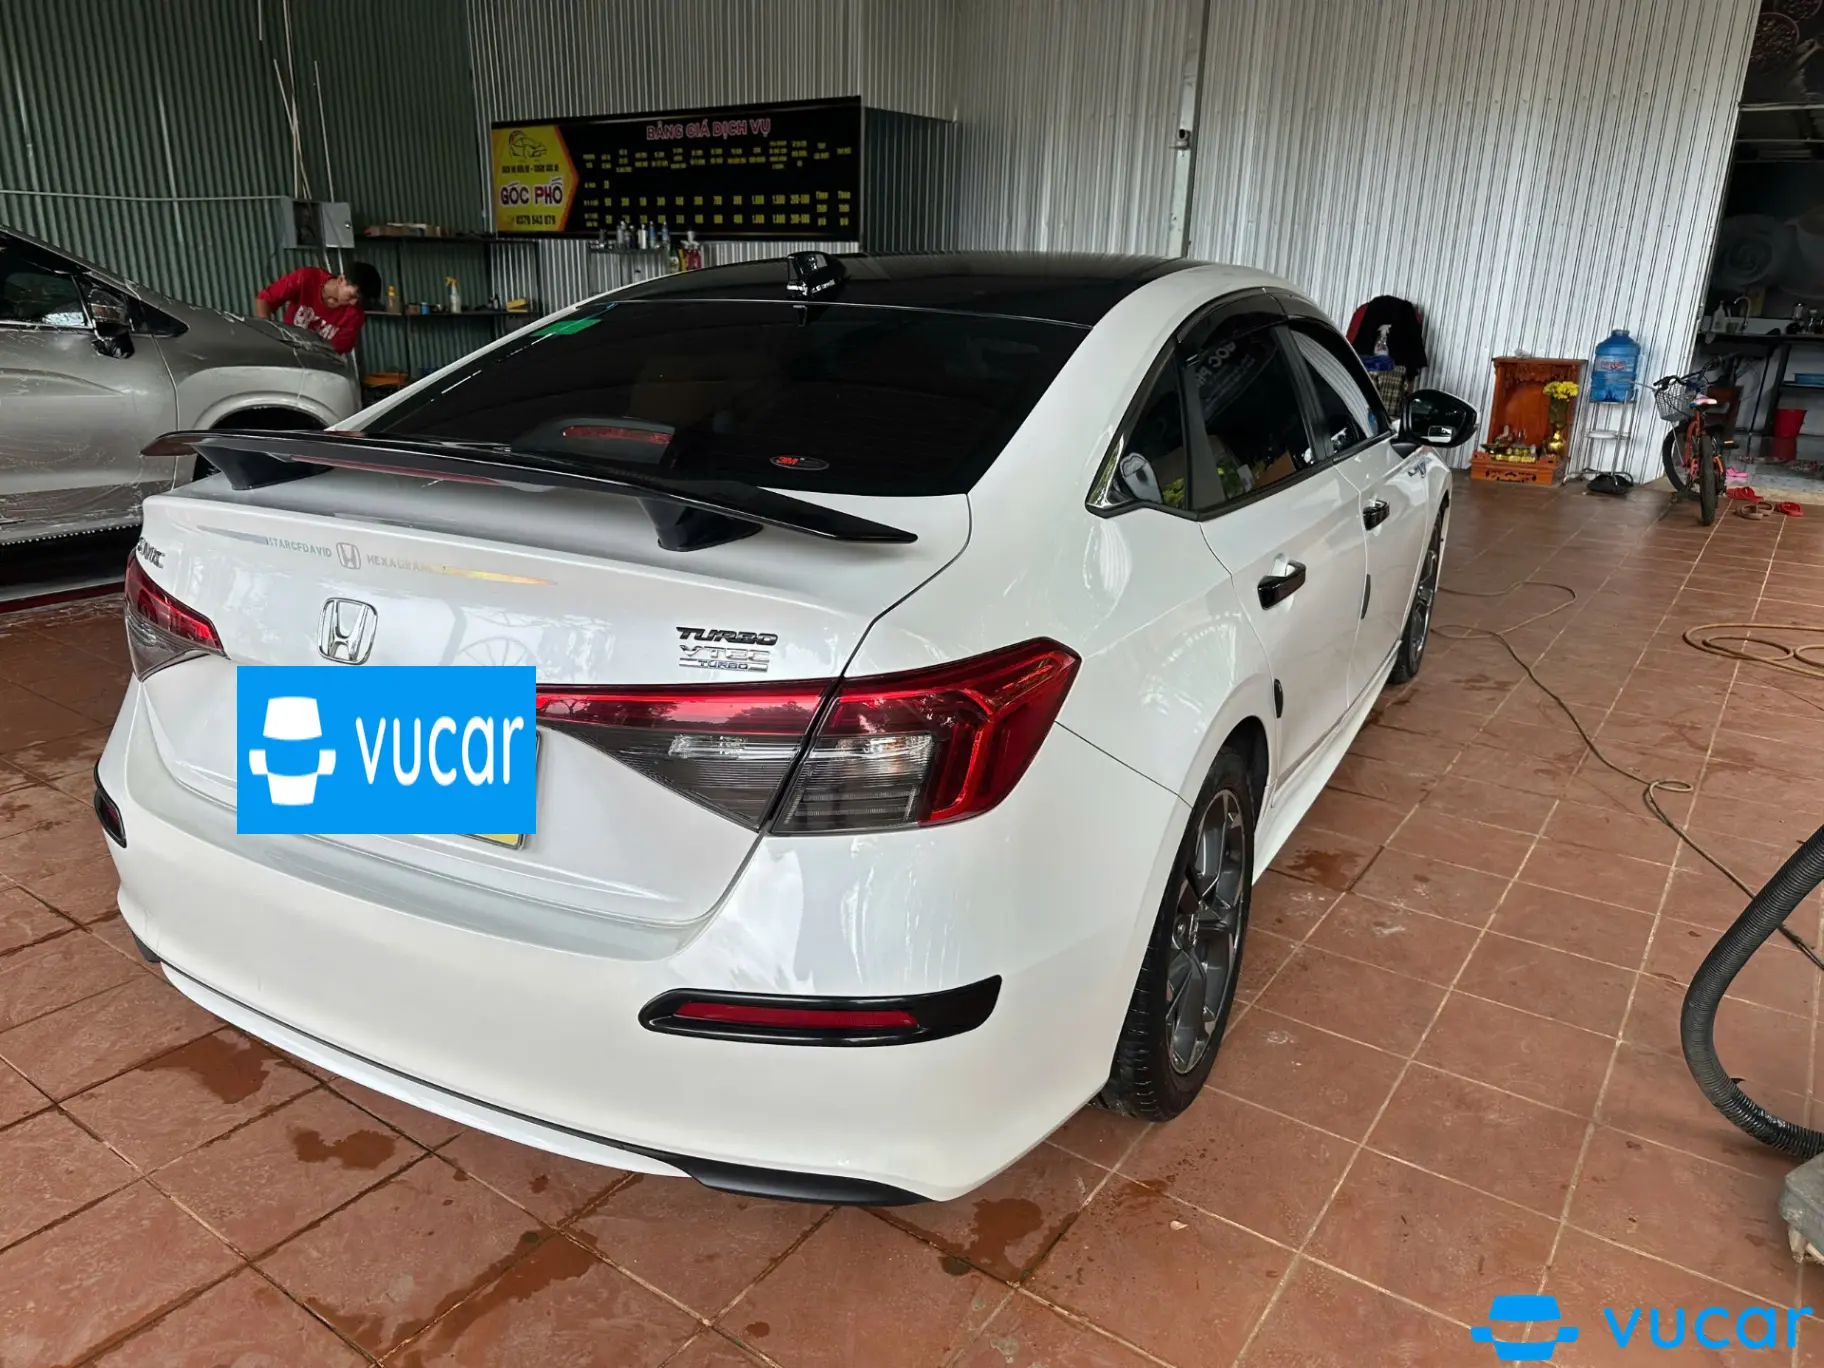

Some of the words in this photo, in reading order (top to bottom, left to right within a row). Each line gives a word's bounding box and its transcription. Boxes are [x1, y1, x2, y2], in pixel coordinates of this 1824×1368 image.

[646, 120, 684, 141] BẢNG
[685, 118, 711, 139] GIÁ
[712, 119, 748, 140] DỊCH
[749, 117, 772, 138] VỤ
[676, 626, 778, 646] TURBO
[679, 644, 771, 662] VTEC
[697, 659, 749, 670] TURBO
